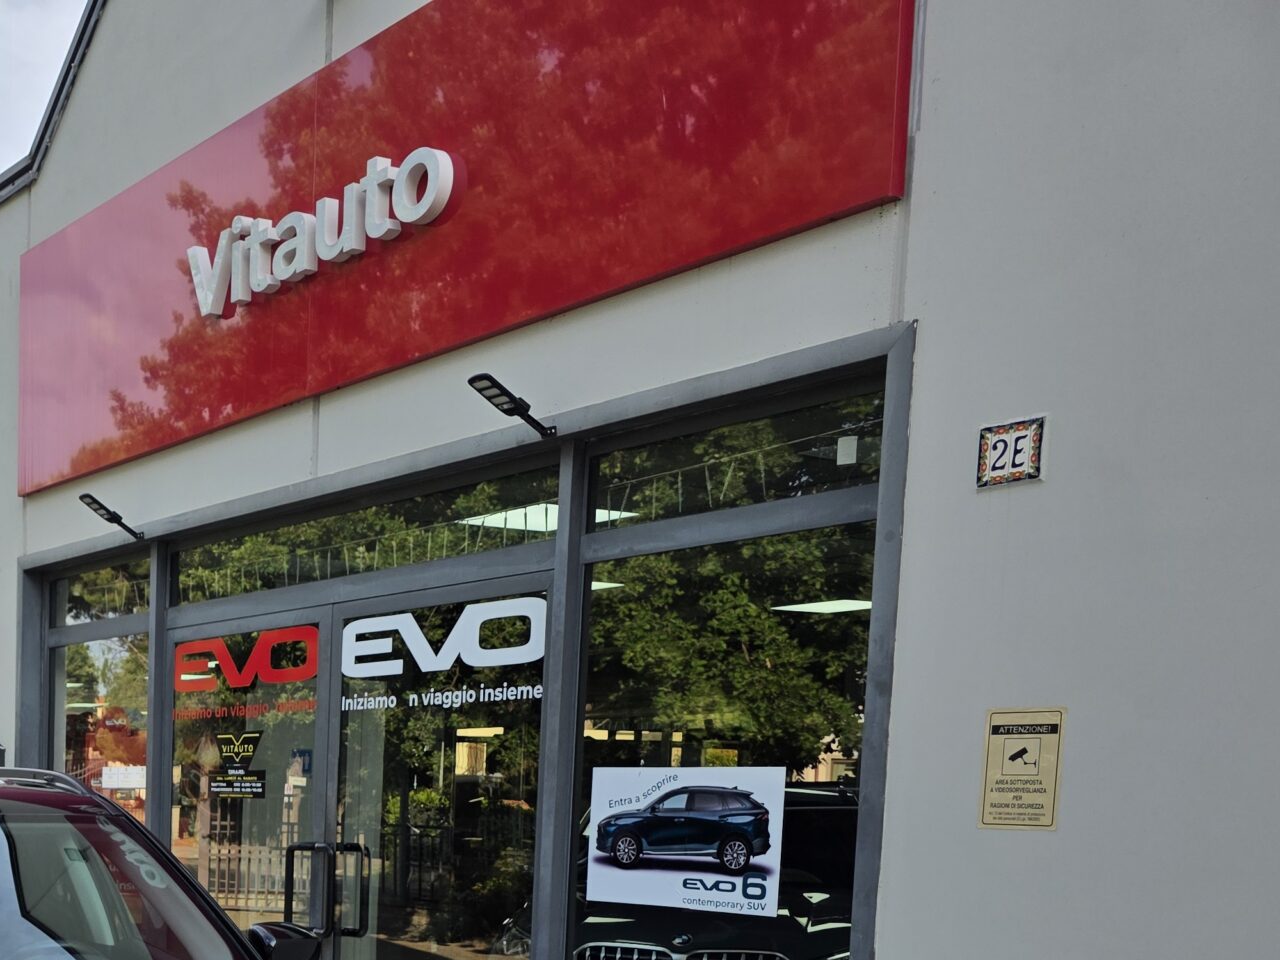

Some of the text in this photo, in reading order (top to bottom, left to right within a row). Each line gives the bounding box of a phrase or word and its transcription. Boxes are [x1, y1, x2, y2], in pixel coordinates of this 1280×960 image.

[186, 147, 454, 318] Vitauto
[991, 434, 1028, 471] 2E
[341, 597, 547, 678] EVO
[174, 625, 318, 693] EVO
[230, 701, 269, 719] viaggio
[341, 692, 397, 711] Iniziamo
[421, 685, 476, 708] viaggio
[479, 682, 544, 702] insieme
[998, 725, 1051, 734] ATTENZIONE!
[221, 744, 254, 753] VITAUTO
[608, 797, 633, 809] Entra
[642, 774, 679, 800] scoprire
[682, 872, 768, 901] EVO 6
[682, 896, 767, 912] contemporary SUV
